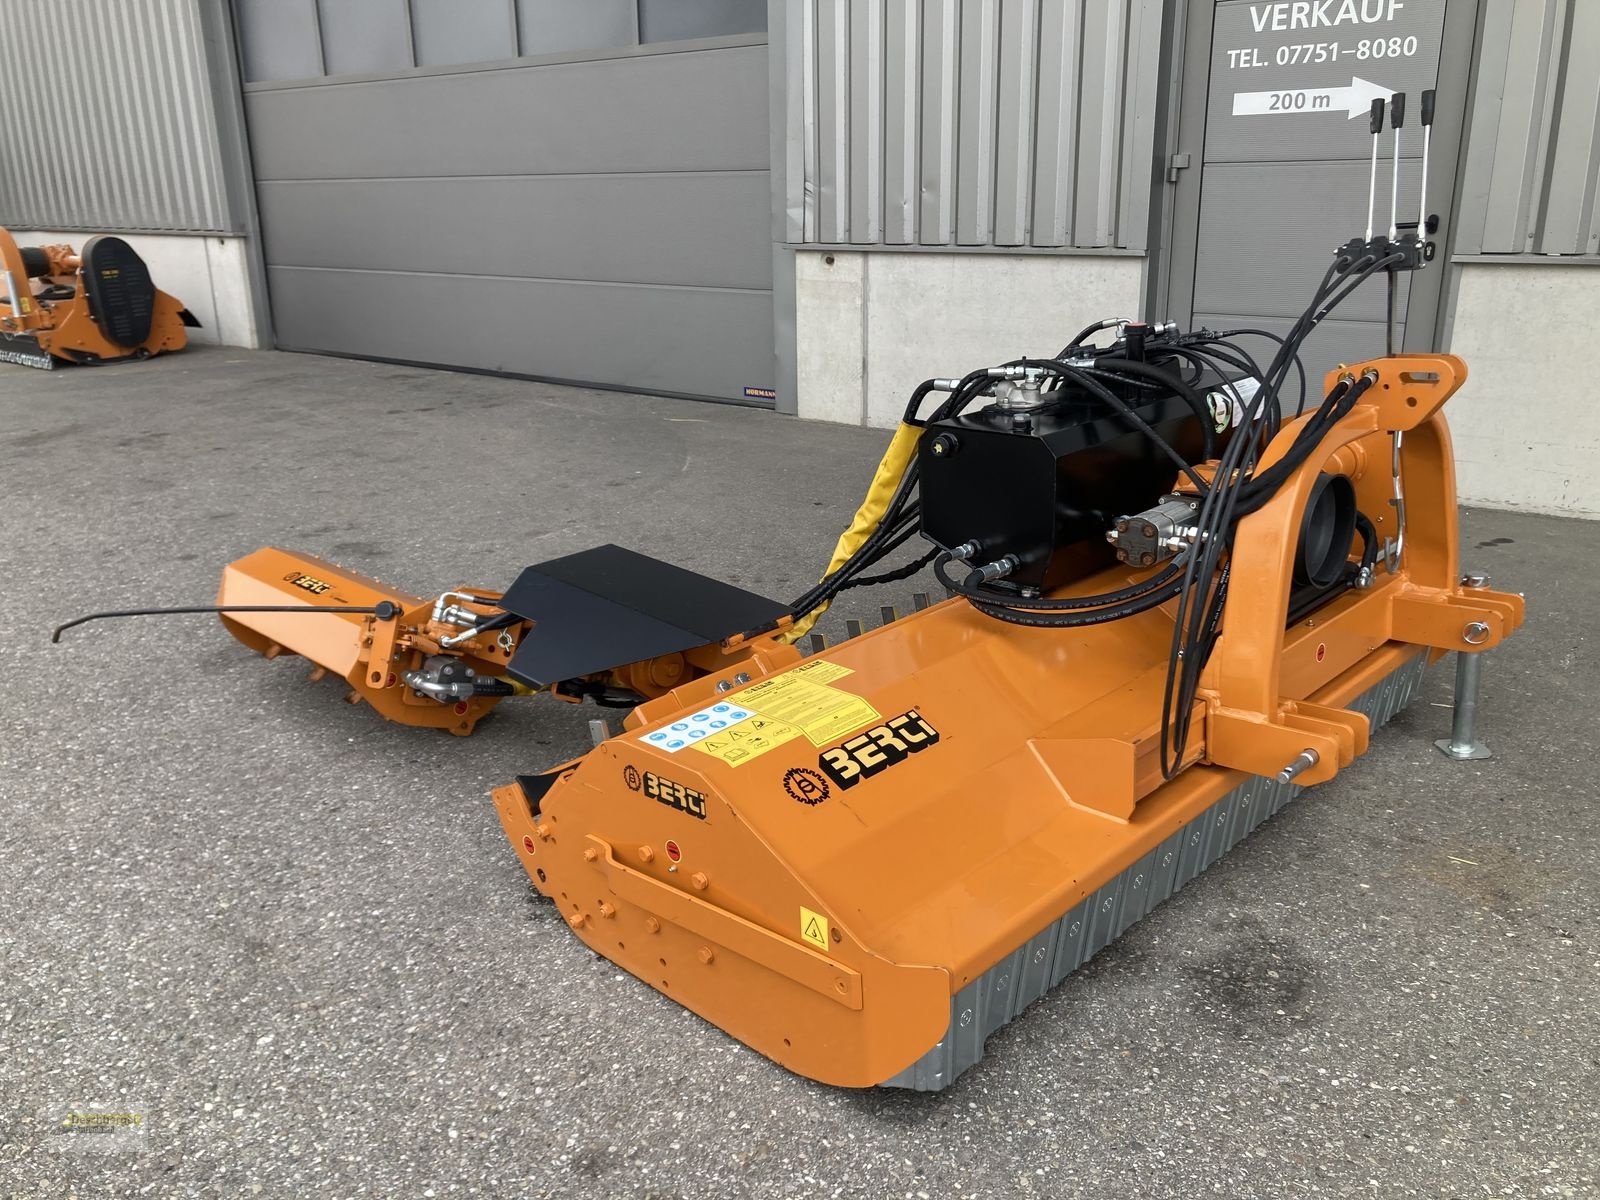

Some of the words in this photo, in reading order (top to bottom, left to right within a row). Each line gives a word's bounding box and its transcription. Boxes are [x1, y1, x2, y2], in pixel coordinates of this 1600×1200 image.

[1250, 0, 1404, 32] VERKAUF
[1227, 48, 1269, 68] TEL.
[1269, 92, 1306, 110] 200
[1312, 94, 1330, 108] m
[819, 709, 940, 791] BERTI
[643, 771, 706, 820] BERTI
